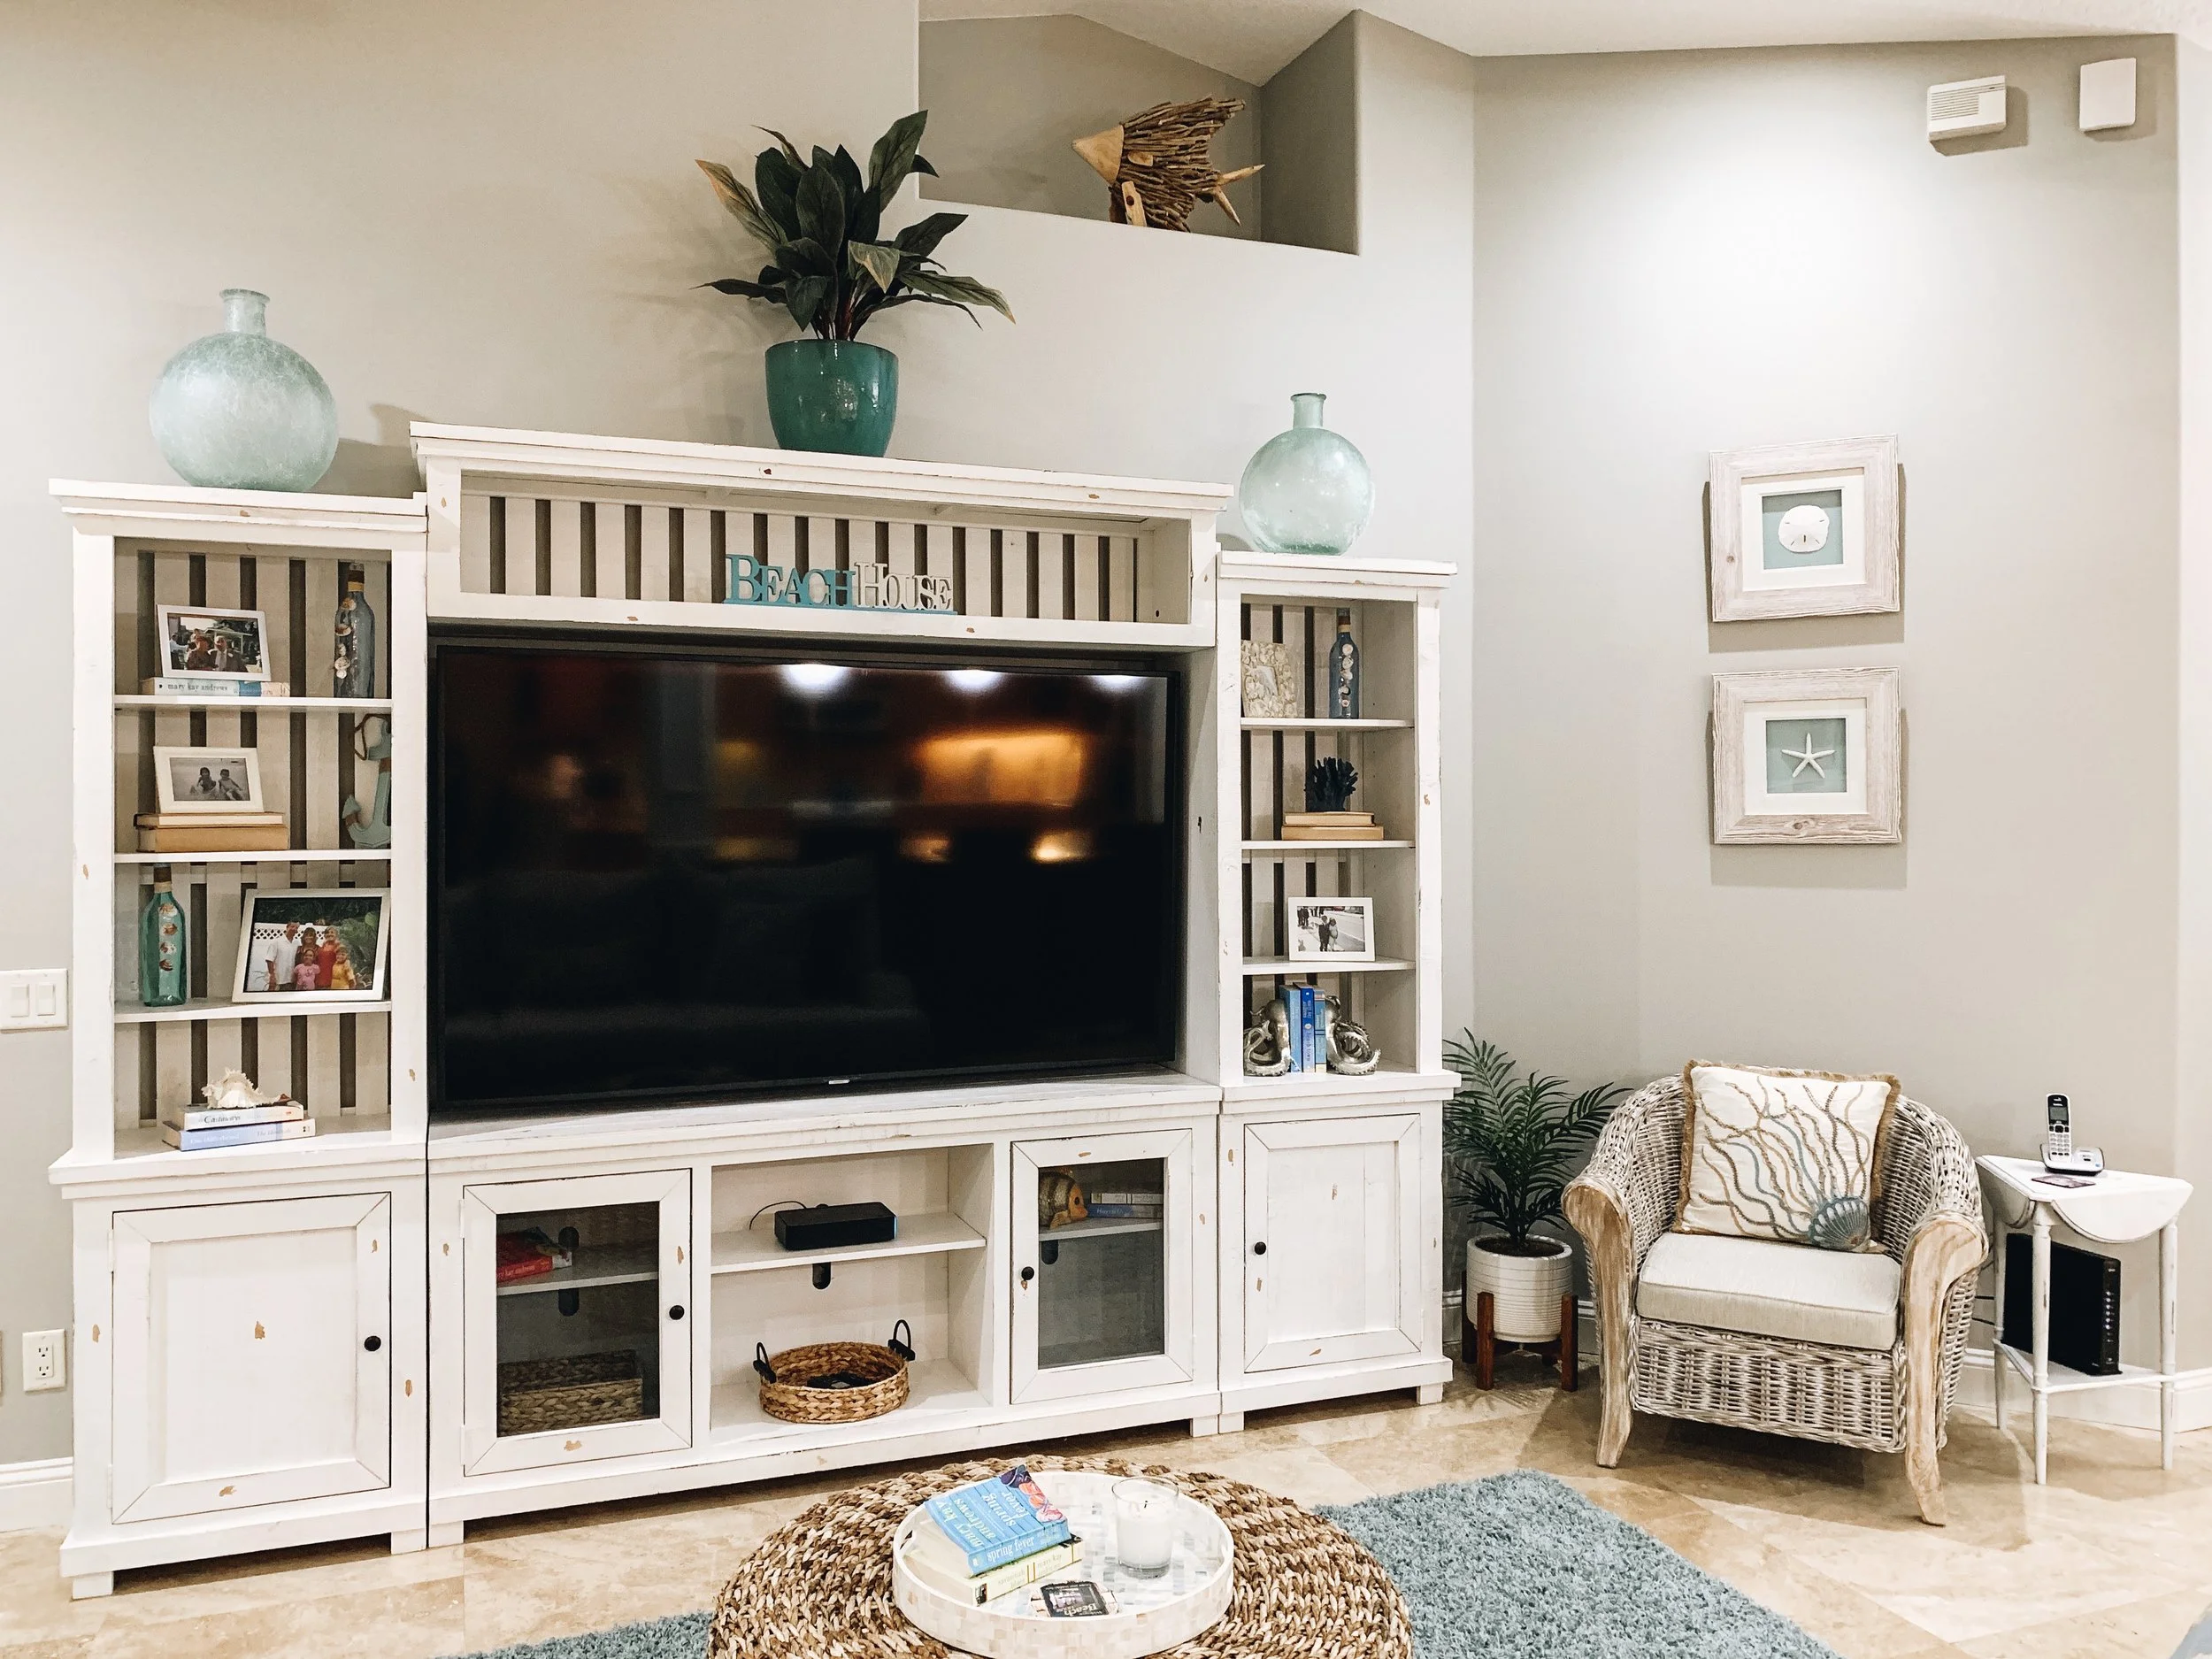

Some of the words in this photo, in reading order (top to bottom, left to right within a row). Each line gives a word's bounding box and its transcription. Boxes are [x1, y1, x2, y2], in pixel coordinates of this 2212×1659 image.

[187, 682, 200, 692] kay
[934, 1500, 957, 1523] kay
[982, 1492, 1017, 1527] spring
[1001, 1491, 1031, 1518] fever
[954, 1498, 996, 1540] andrews
[956, 1523, 984, 1548] mary
[987, 1543, 1013, 1563] spring
[1014, 1536, 1034, 1552] fever
